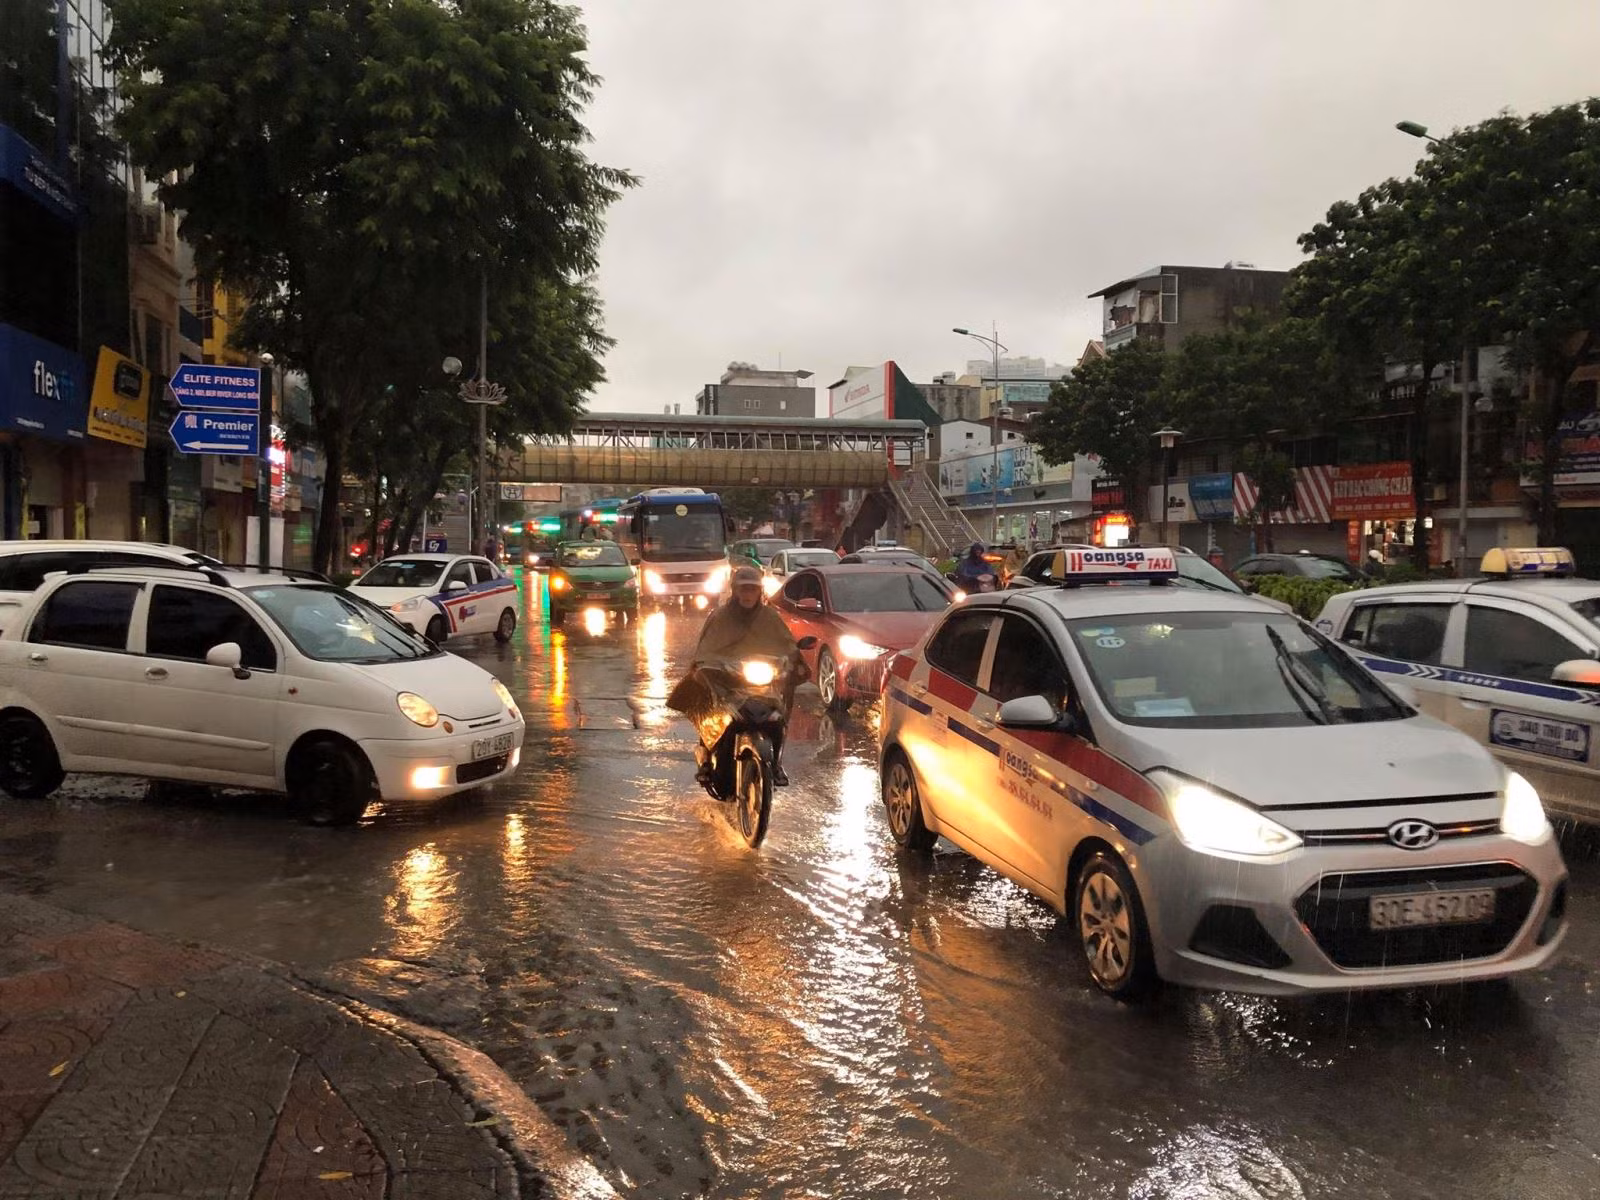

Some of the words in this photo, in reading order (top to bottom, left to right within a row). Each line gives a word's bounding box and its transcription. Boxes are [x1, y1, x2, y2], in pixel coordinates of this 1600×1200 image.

[183, 374, 212, 385] ELITE
[214, 376, 256, 388] FITNESS
[203, 419, 254, 432] Premier
[1147, 558, 1173, 570] TAXI
